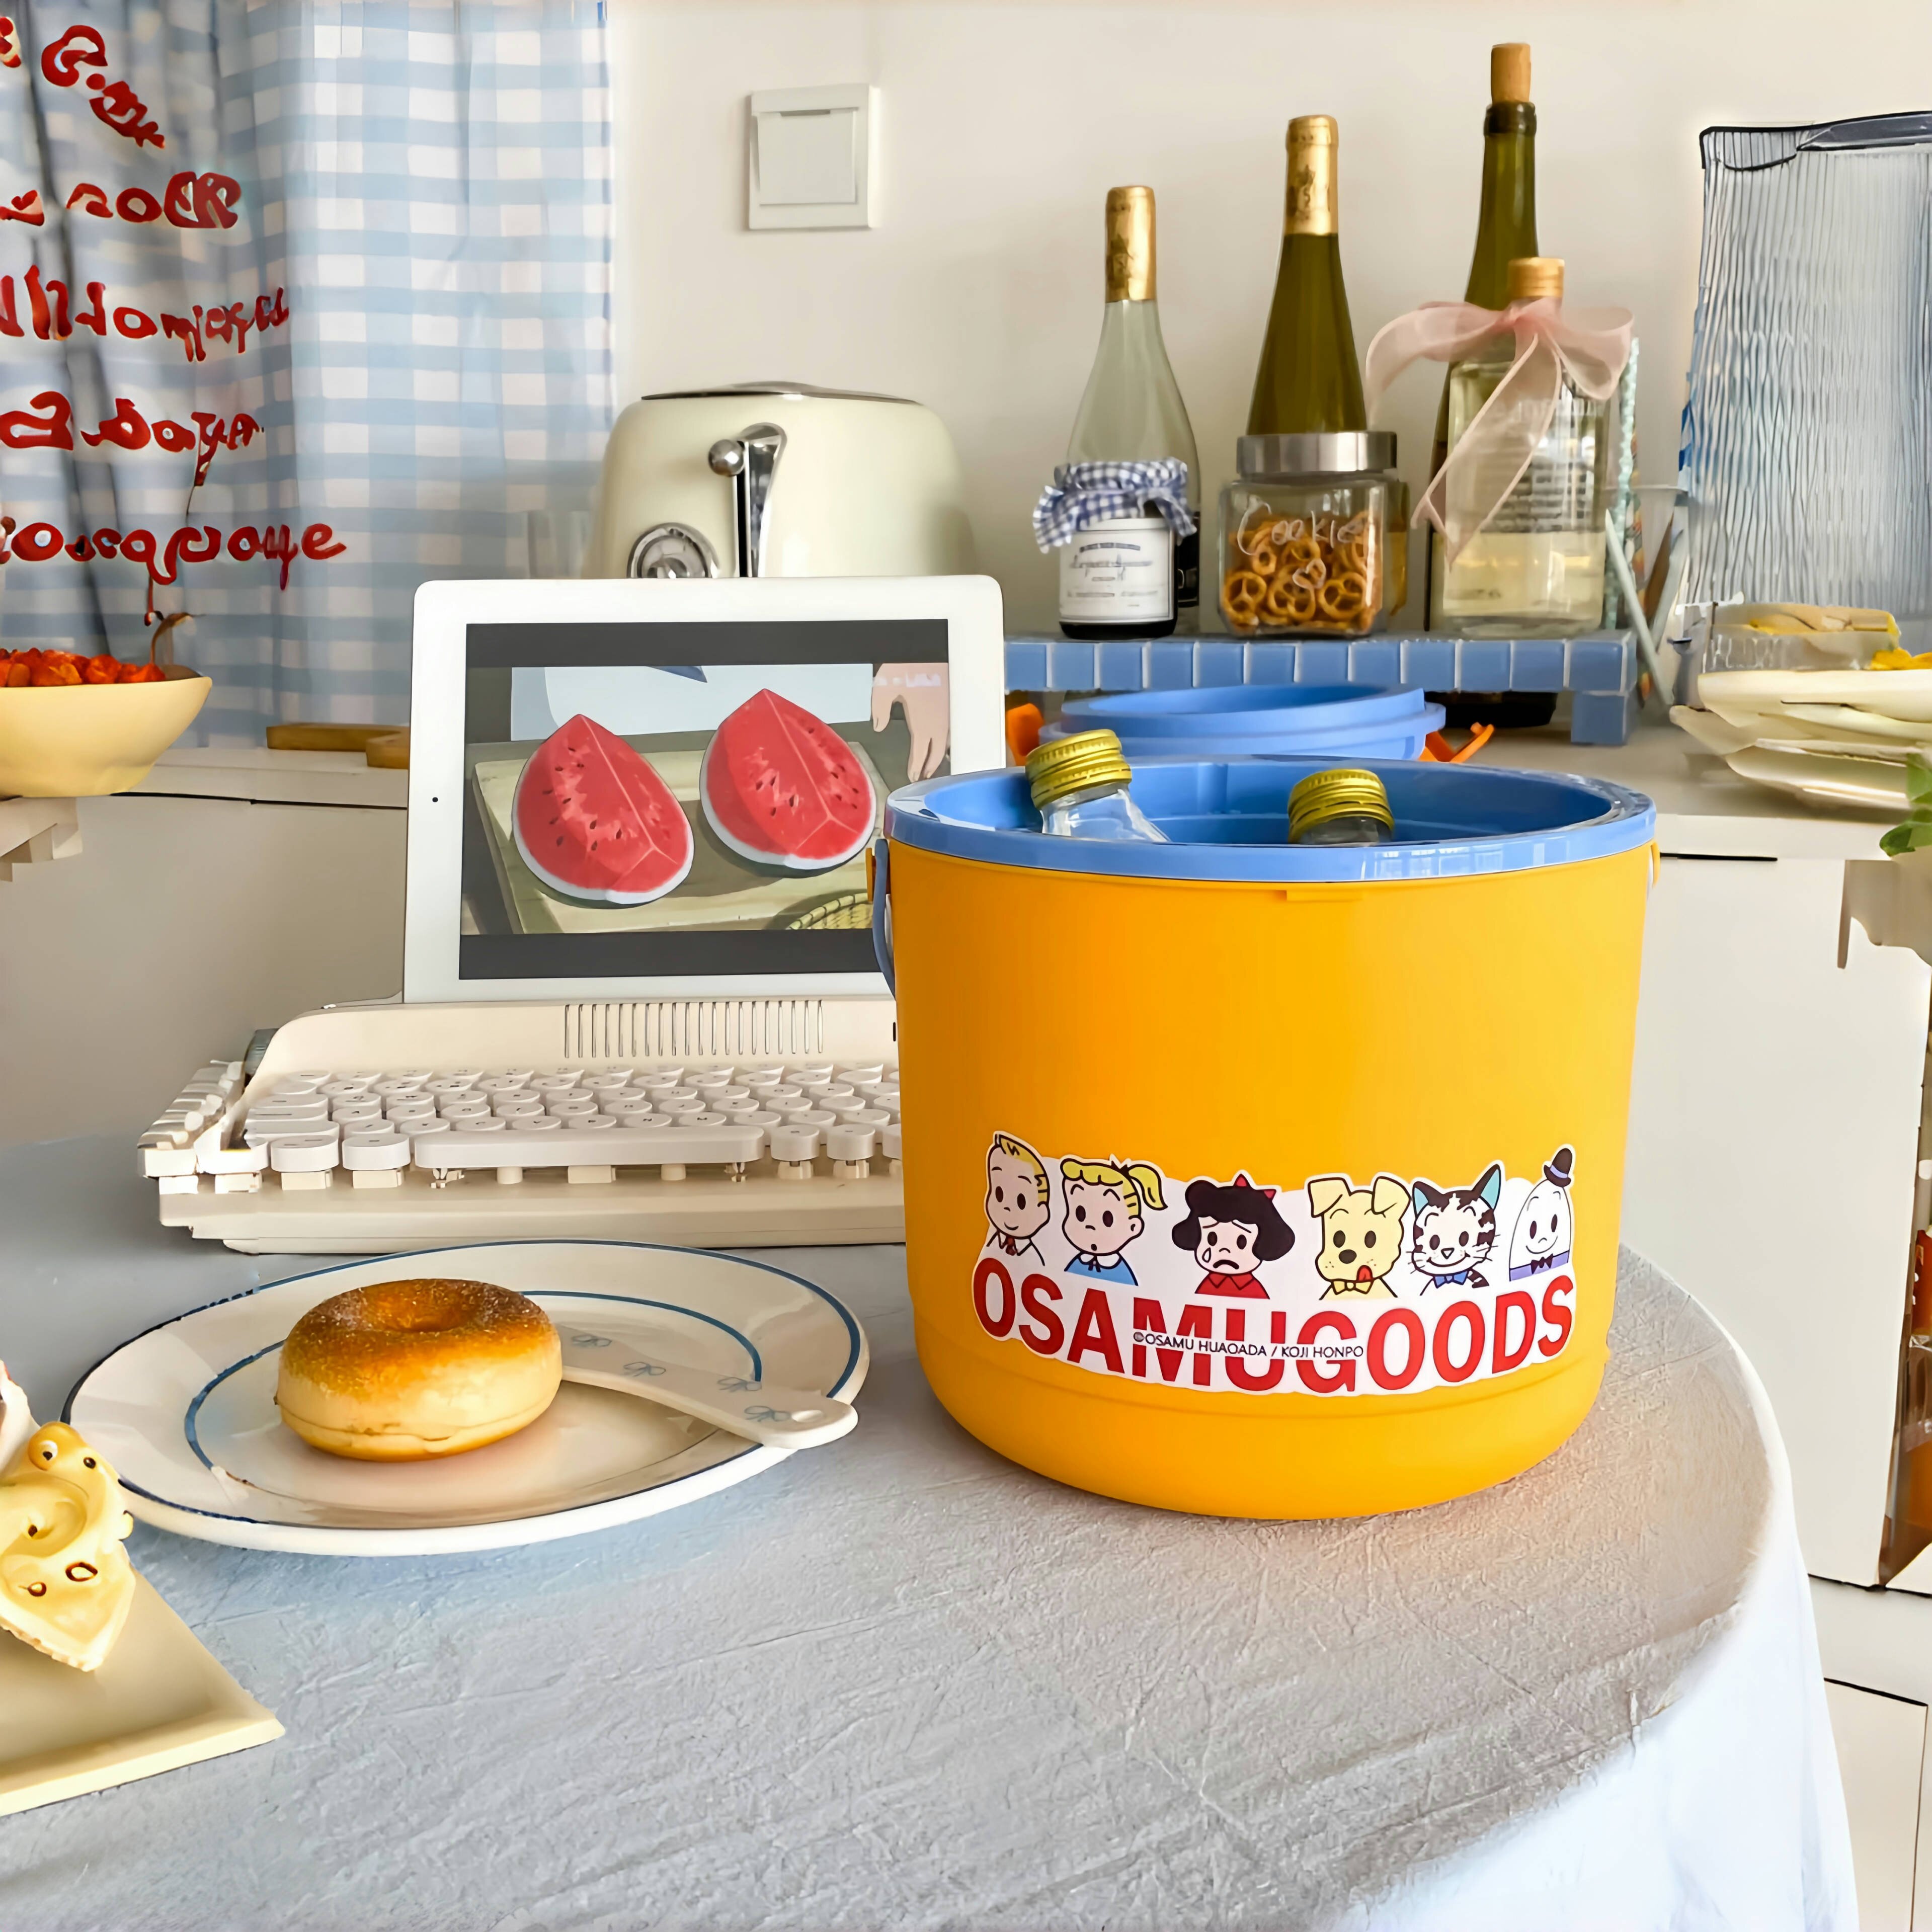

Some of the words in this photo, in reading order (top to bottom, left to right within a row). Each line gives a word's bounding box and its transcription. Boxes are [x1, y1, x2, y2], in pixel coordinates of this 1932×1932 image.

[973, 1275, 1573, 1393] OSAMUGOODS
[1281, 1346, 1309, 1358] KOJI
[1313, 1345, 1364, 1358] HONPO
